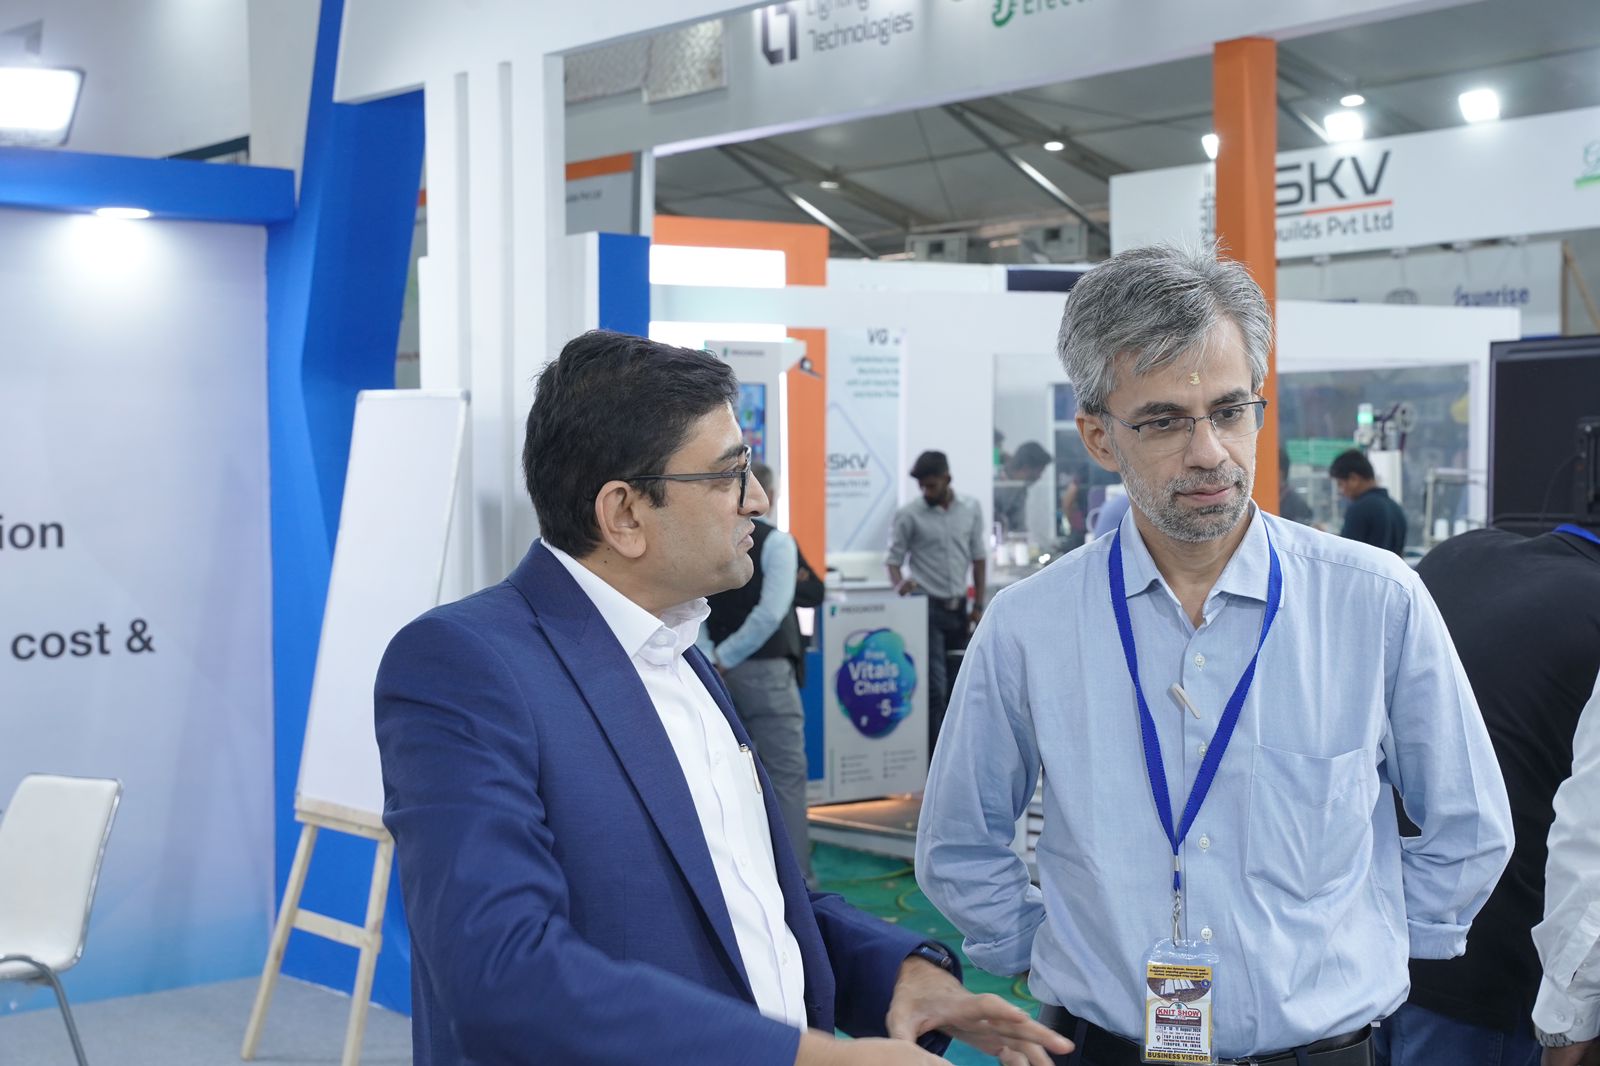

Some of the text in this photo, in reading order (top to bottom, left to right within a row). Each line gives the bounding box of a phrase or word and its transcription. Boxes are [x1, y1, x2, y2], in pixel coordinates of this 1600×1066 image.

[807, 12, 914, 53] Technologies
[1276, 150, 1390, 206] SKV
[1275, 210, 1393, 242] uilds Pvt Ltd
[11, 617, 156, 661] cost &
[848, 660, 900, 681] Vitals
[854, 679, 898, 697] Check
[1177, 1008, 1200, 1017] SHOW
[1147, 1052, 1180, 1060] BUSINESS
[1181, 1053, 1209, 1061] VISITOR
